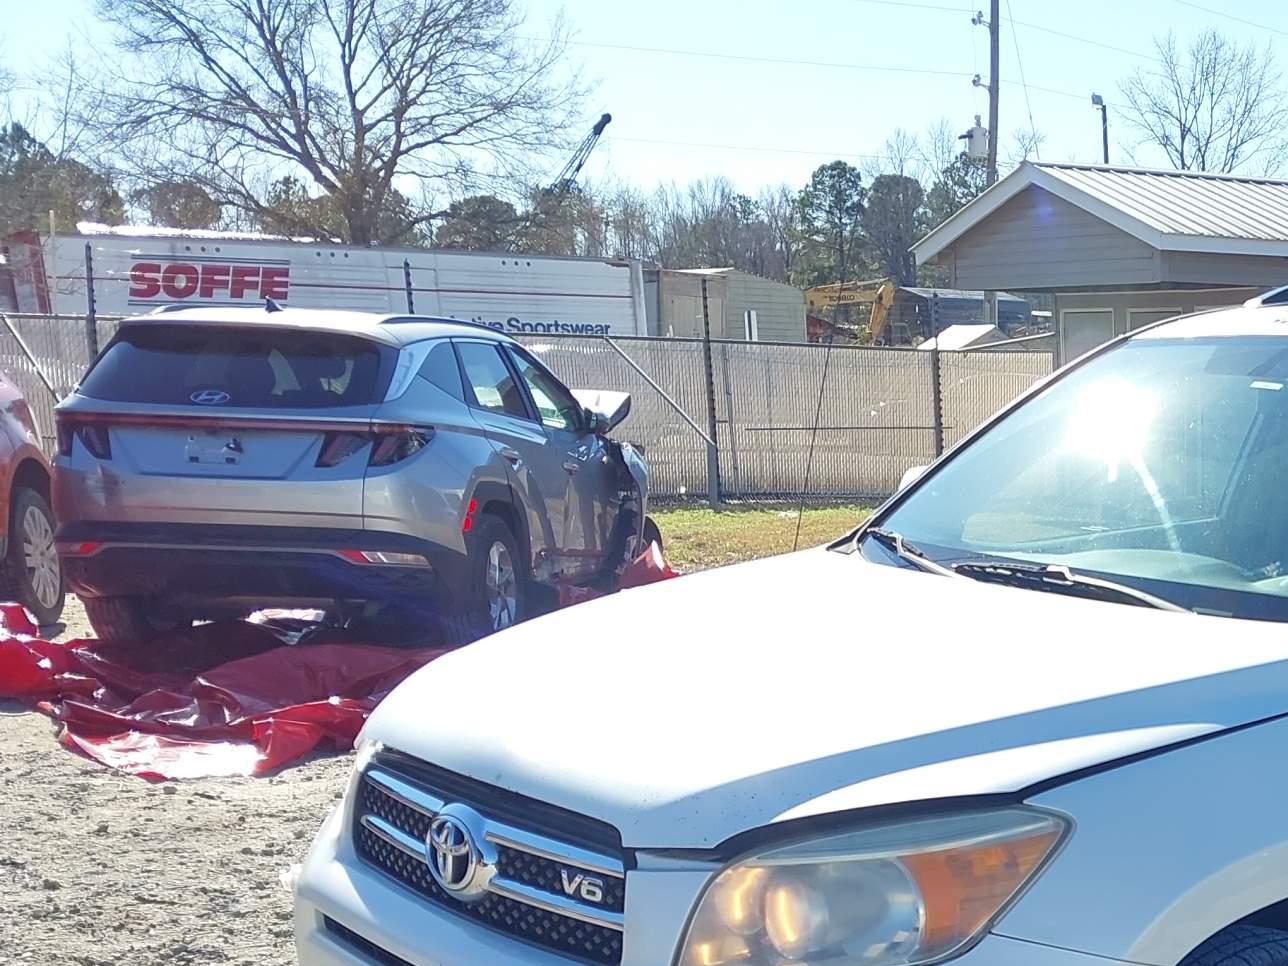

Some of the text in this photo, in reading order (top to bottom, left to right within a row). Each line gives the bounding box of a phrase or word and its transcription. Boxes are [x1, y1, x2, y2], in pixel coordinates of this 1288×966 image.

[129, 262, 290, 300] SOFFE
[506, 316, 611, 335] Sportswear
[561, 868, 603, 902] V6
